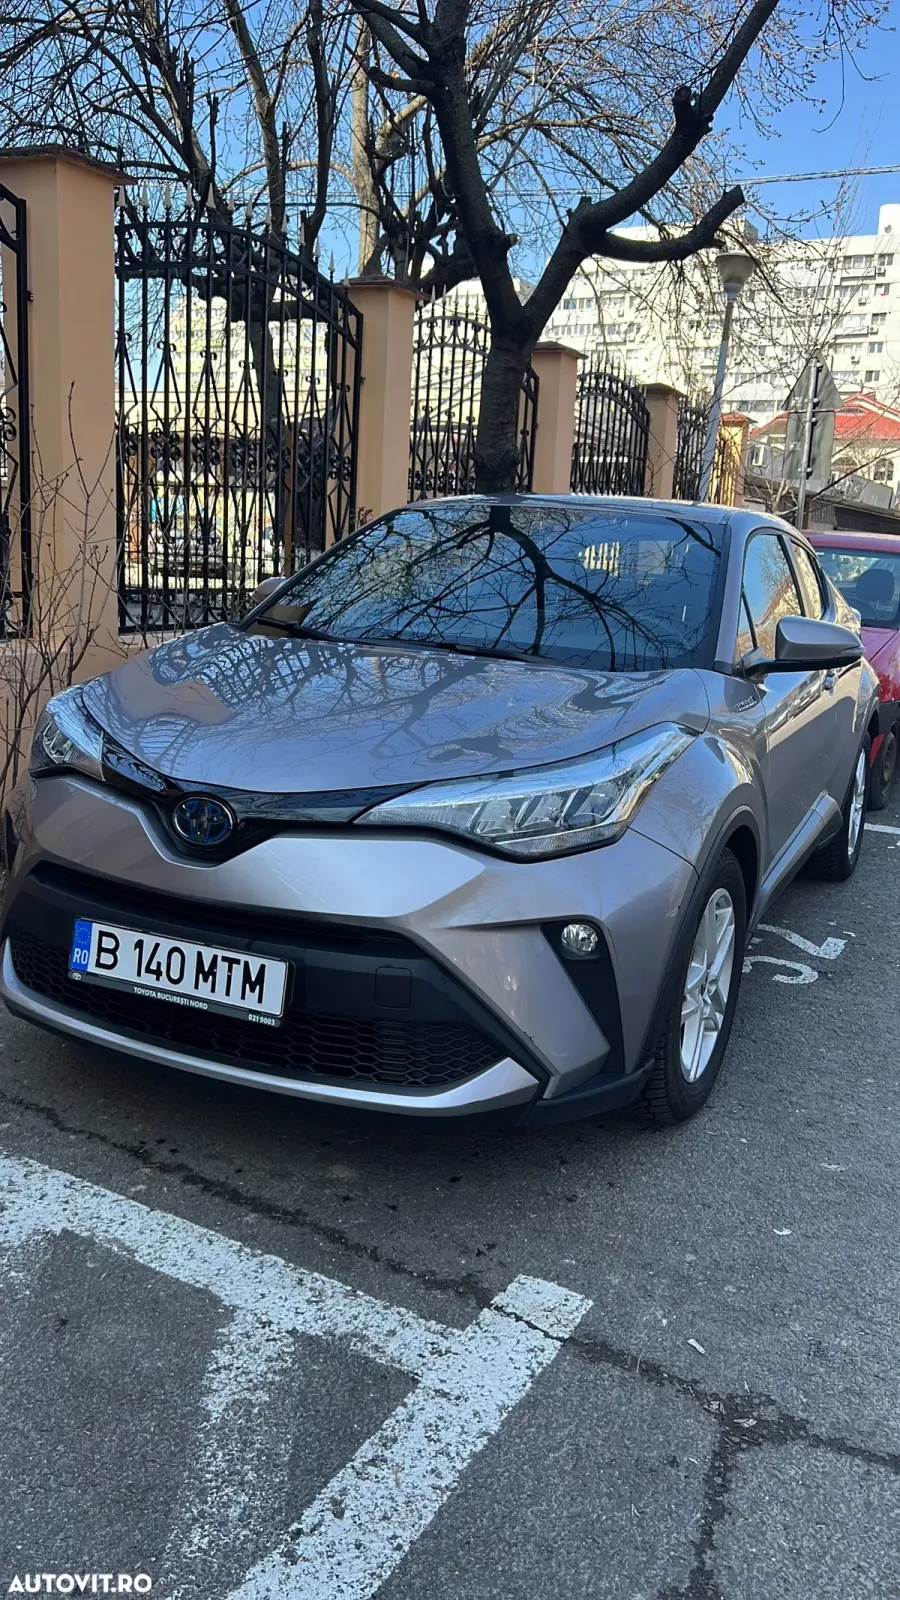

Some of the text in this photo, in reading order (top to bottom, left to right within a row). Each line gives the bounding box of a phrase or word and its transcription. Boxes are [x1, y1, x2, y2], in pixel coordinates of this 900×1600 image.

[73, 948, 89, 965] RO
[95, 930, 267, 1005] B 140 MTM
[133, 986, 157, 998] TOYOTA
[189, 1000, 209, 1010] NORD
[248, 1013, 276, 1027] 021 9003
